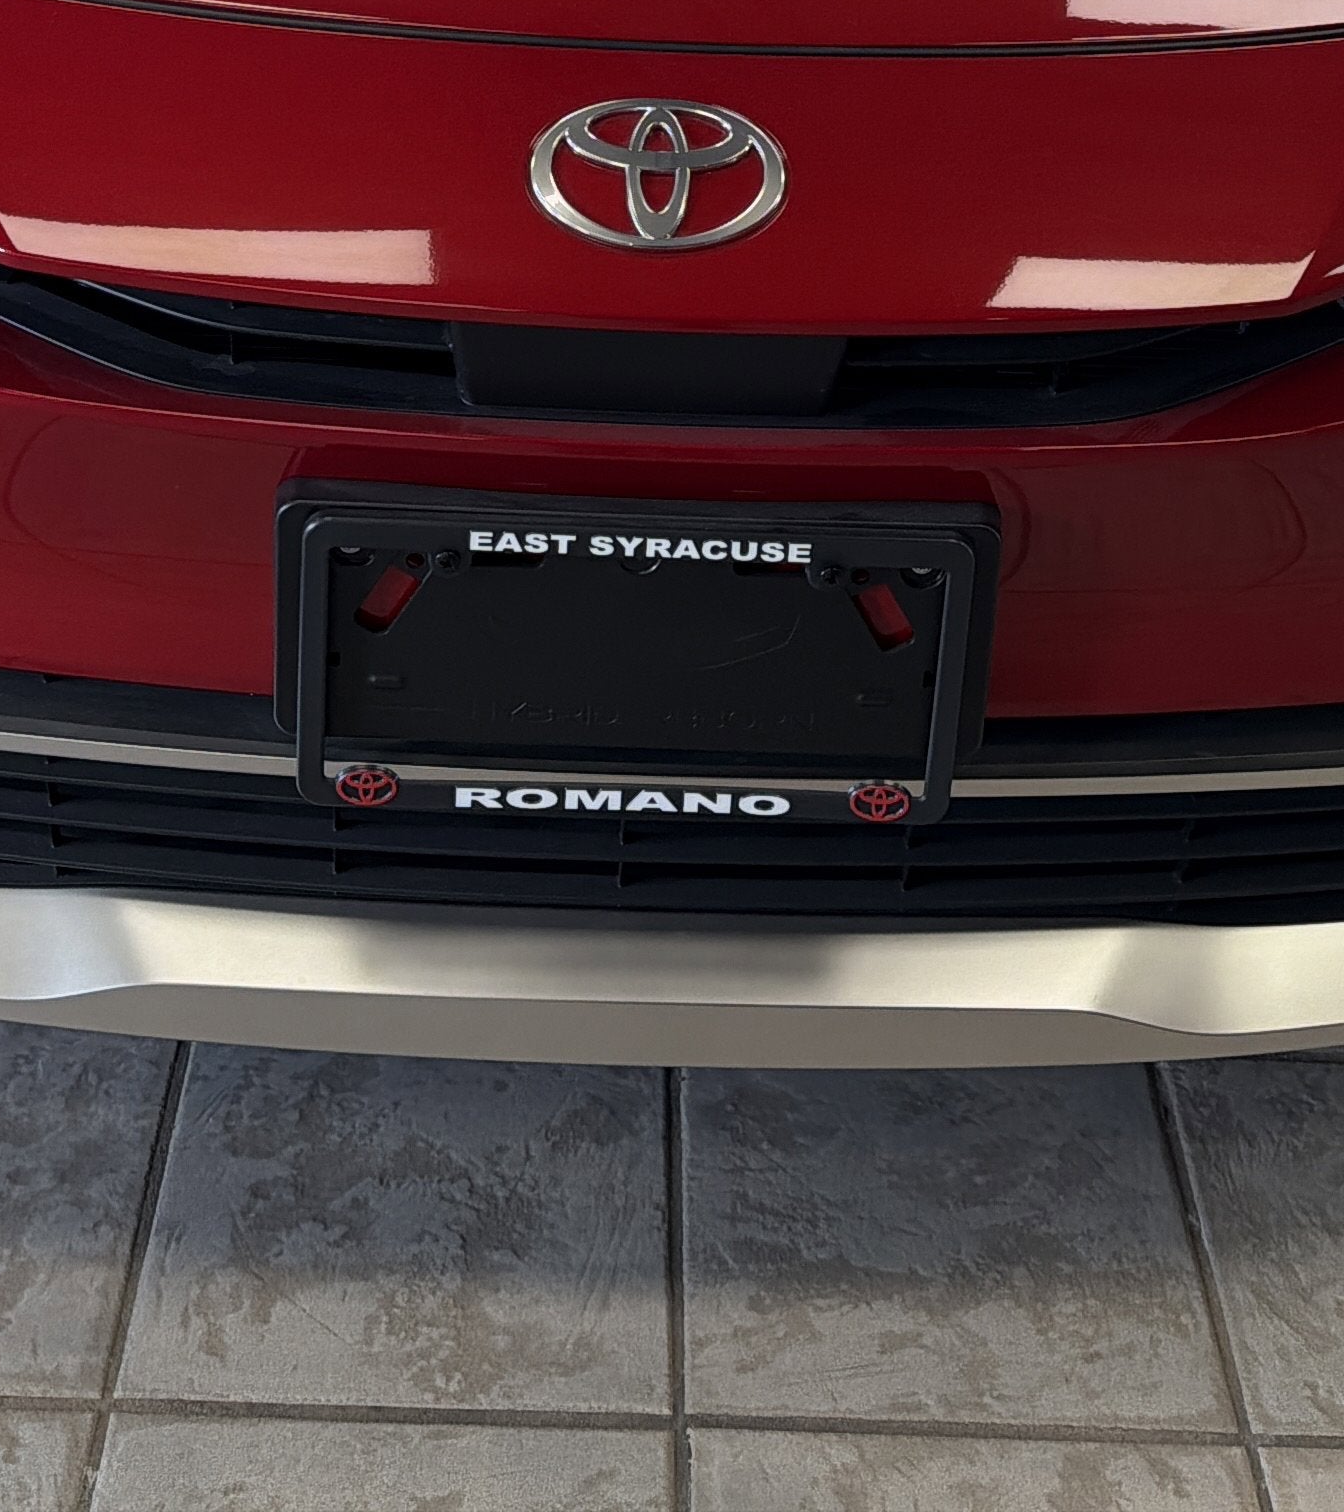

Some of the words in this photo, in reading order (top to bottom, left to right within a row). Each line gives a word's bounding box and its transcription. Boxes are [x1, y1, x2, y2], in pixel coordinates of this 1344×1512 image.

[469, 530, 577, 555] EAST
[589, 535, 813, 563] SYRACUSE
[455, 787, 791, 816] ROMANO
